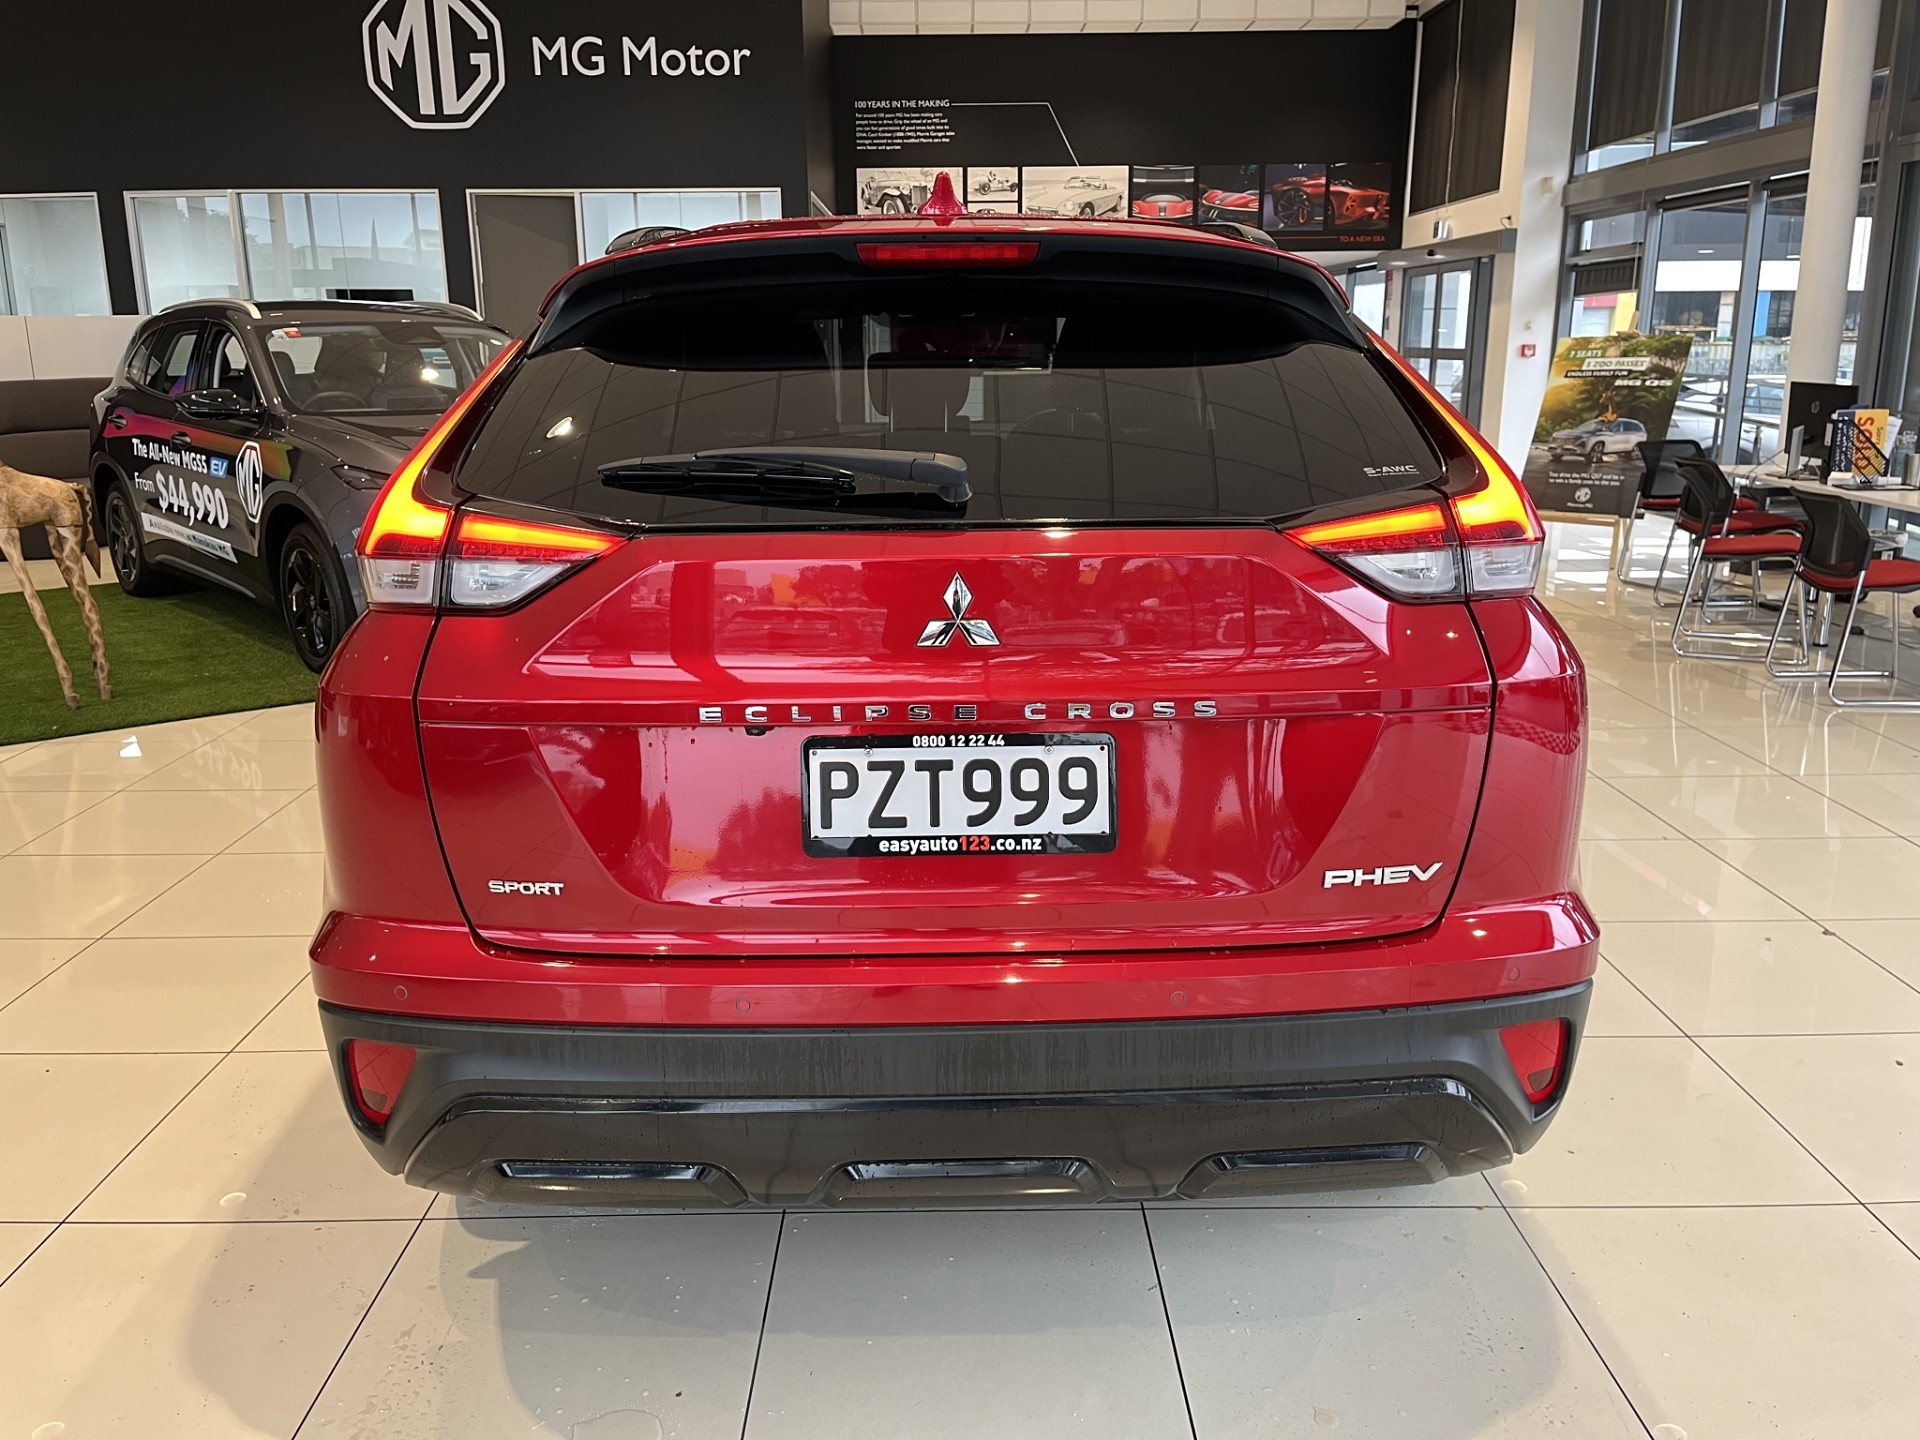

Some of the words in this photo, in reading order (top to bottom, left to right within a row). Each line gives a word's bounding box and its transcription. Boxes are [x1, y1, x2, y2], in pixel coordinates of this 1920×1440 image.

[370, 0, 499, 121] MG
[532, 36, 605, 76] MG
[622, 36, 751, 76] Motor
[902, 100, 917, 108] THE
[918, 100, 950, 108] MAKING
[1576, 350, 1602, 358] SEATS
[132, 438, 147, 458] The
[148, 442, 180, 467] All-New
[181, 450, 208, 474] MGS5
[210, 460, 227, 476] EV
[1363, 465, 1418, 474] S-AWC
[237, 443, 262, 521] MG
[134, 472, 155, 493] From
[156, 470, 229, 530] $44,990
[699, 704, 979, 724] ECLIPSE
[1024, 700, 1219, 720] CROSS
[912, 735, 946, 748] 0800
[950, 735, 966, 747] 12
[968, 734, 985, 746] 22
[987, 734, 1005, 746] 44
[819, 757, 1100, 830] PZT999
[878, 835, 1042, 855] easyauto123.co.nz
[1323, 862, 1443, 888] PHEV
[488, 880, 564, 896] SPORT
